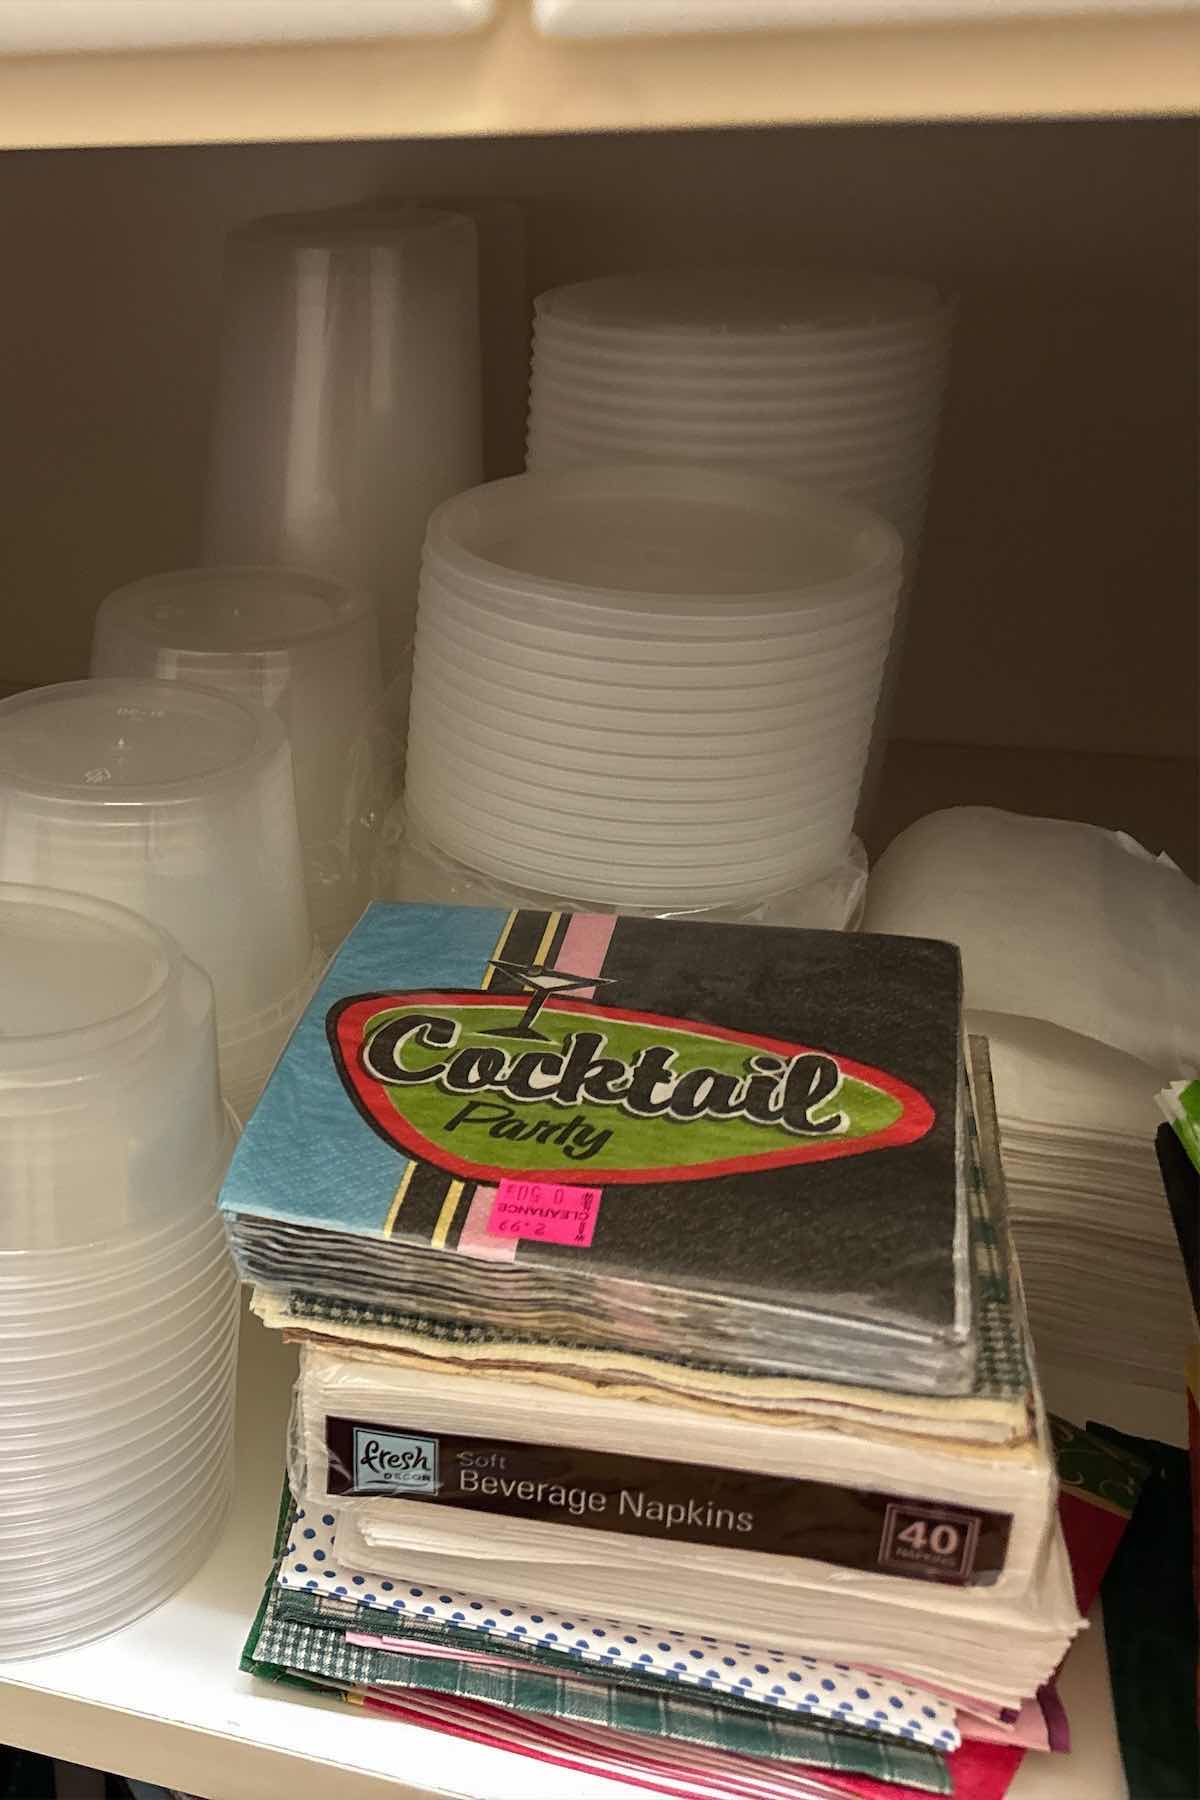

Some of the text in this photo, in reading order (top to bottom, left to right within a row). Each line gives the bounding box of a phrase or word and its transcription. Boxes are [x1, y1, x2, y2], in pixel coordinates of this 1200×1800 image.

[361, 1014, 850, 1136] Cocktail
[442, 1099, 613, 1160] Party
[497, 1202, 590, 1221] CLEARANCE
[498, 1220, 546, 1237] 2.99
[360, 1439, 432, 1473] fresh
[457, 1450, 507, 1470] Soft
[459, 1469, 753, 1533] Beverage Napkins
[897, 1520, 959, 1555] 40
